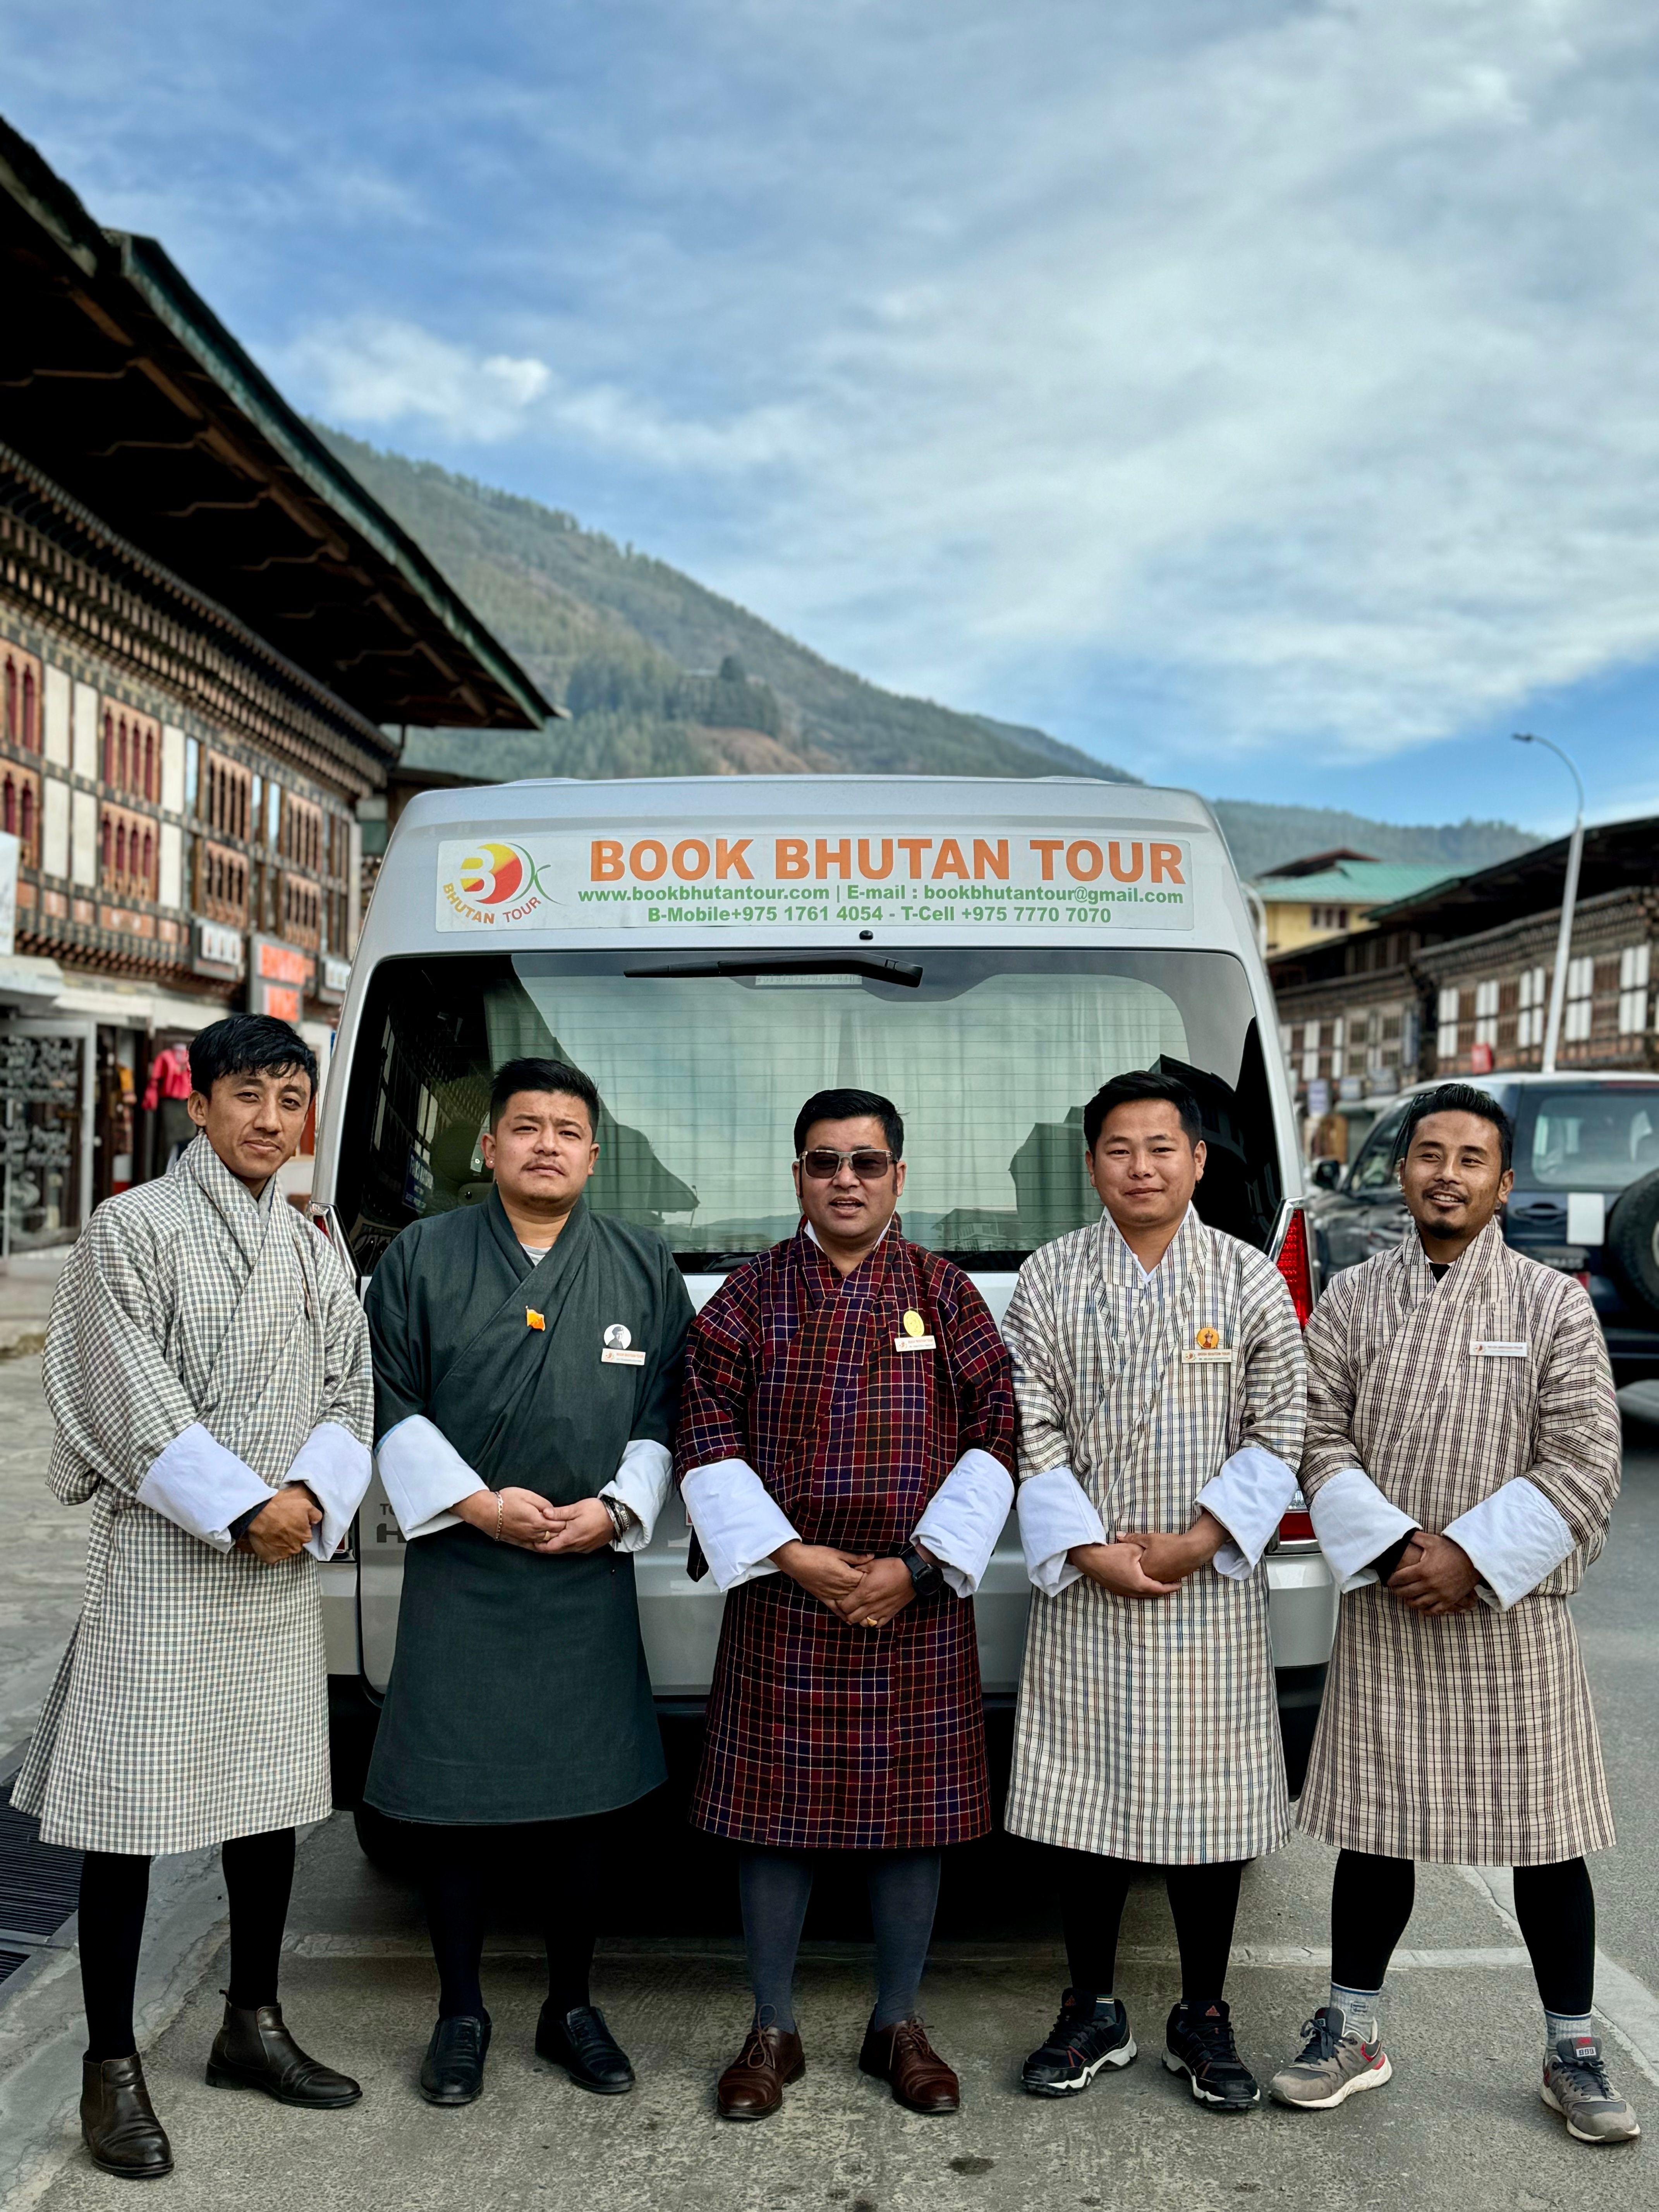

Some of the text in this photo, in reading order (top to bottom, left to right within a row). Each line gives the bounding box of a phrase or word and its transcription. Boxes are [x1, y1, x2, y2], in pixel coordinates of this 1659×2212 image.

[591, 839, 1185, 884] BOOK BHUTAN TOUR
[443, 883, 542, 924] BHUTAN TOUR
[578, 886, 830, 902] www.bookbhutantour.com
[847, 885, 905, 900] E-mail
[924, 885, 1183, 904] bookbhutantour@gmail.com
[648, 906, 777, 922] B-Mobile+975
[785, 906, 828, 921] 1761
[836, 906, 883, 921] 4054
[901, 905, 954, 921] T-Cell
[961, 906, 1007, 922] +975
[1015, 907, 1060, 922] 7770
[1066, 907, 1111, 923] 7070
